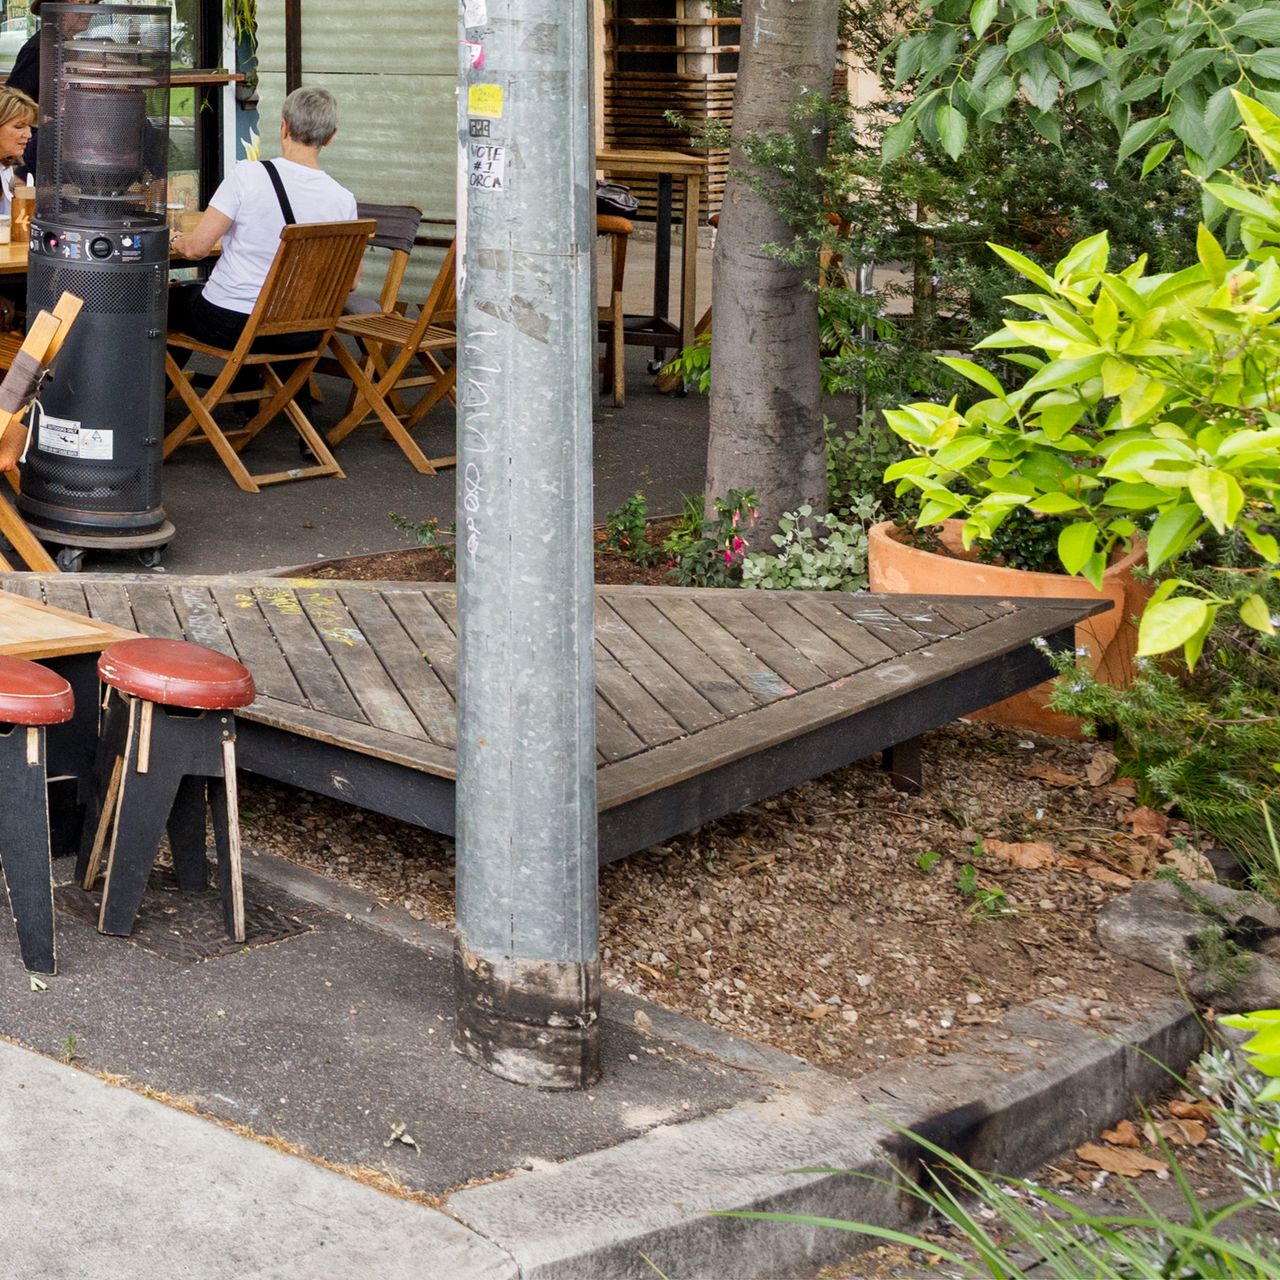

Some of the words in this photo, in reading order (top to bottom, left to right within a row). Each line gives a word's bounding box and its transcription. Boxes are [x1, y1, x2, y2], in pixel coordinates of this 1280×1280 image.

[470, 144, 503, 161] VOTE
[469, 173, 502, 188] ORCA
[15, 207, 30, 231] 4
